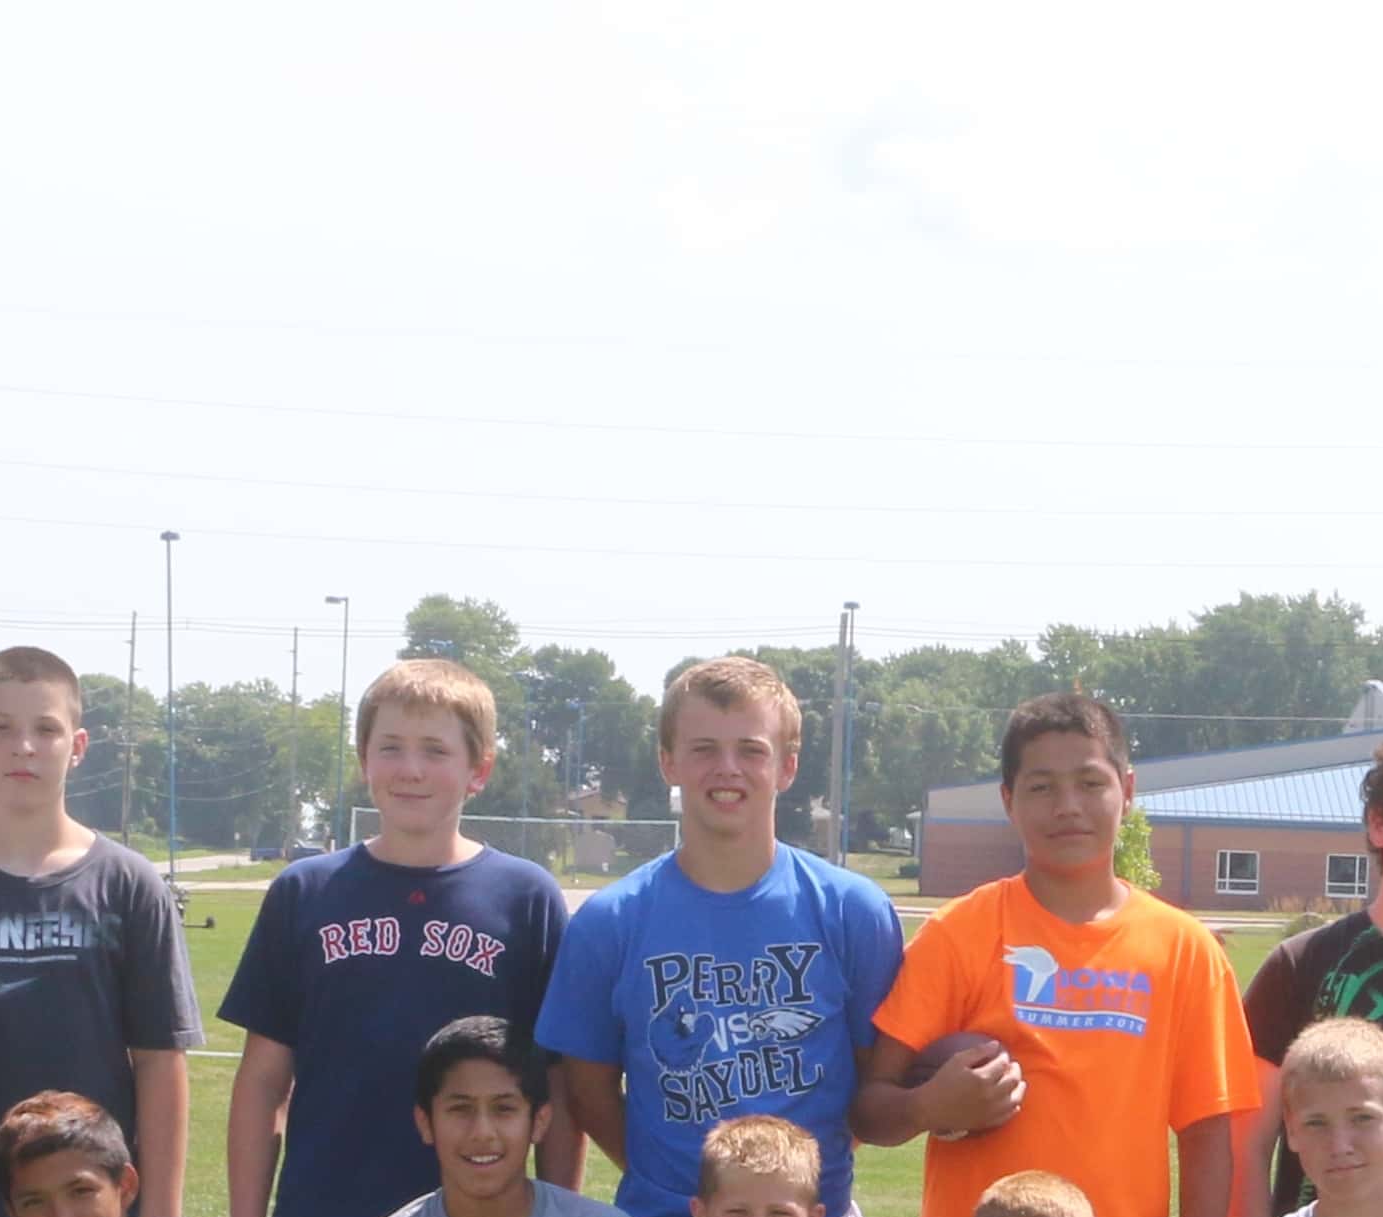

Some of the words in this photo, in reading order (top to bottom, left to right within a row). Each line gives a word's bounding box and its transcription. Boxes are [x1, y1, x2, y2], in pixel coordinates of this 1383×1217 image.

[319, 917, 401, 964] RED
[420, 920, 506, 977] SOX
[644, 942, 823, 1014] PERRY
[1059, 967, 1152, 994] IOWA
[1017, 1009, 1095, 1027] SUMMER
[659, 1045, 825, 1124] SAYDEL
